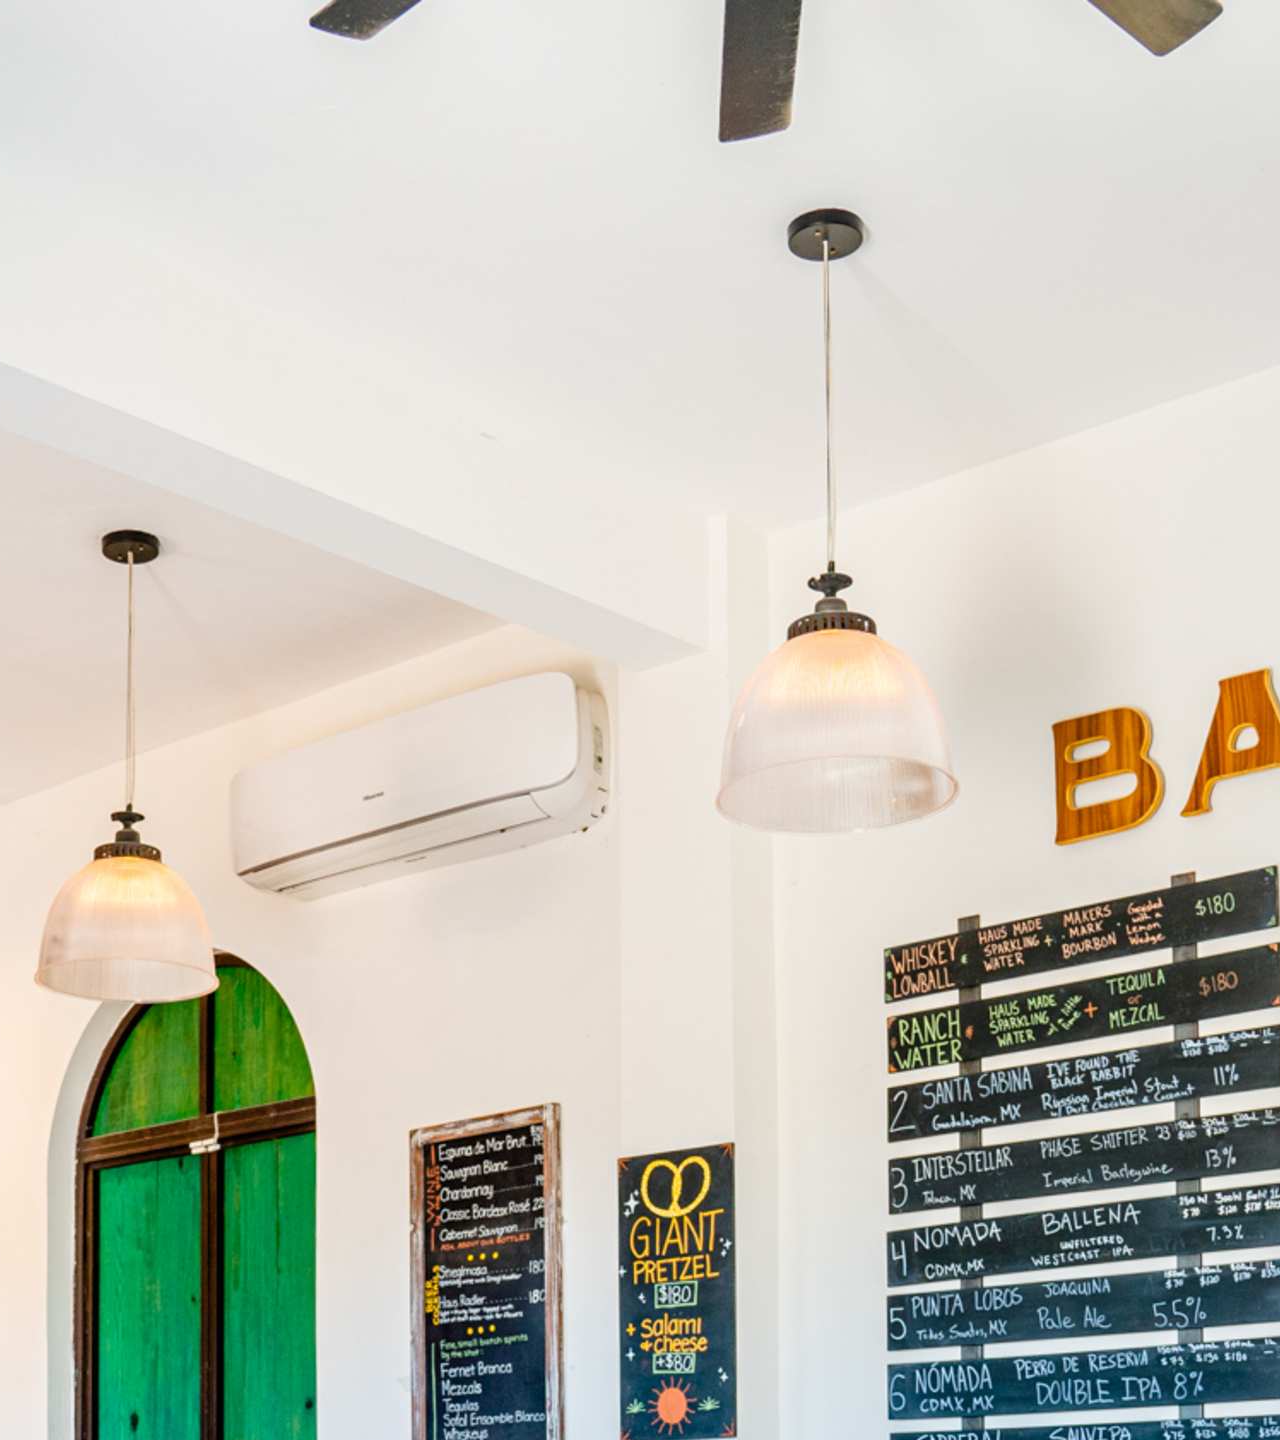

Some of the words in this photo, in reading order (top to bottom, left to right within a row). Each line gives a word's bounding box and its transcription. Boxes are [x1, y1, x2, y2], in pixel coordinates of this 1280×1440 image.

[1063, 904, 1112, 927] MAKERS
[1195, 892, 1236, 916] $180
[978, 926, 1007, 945] HAUS
[1013, 918, 1043, 936] MADE
[1070, 920, 1104, 938] MARK
[1126, 922, 1161, 934] Lemon
[890, 937, 959, 975] WHISKEY
[984, 935, 1040, 957] SPARKLING
[1061, 932, 1117, 959] BOURBON
[984, 953, 1024, 973] WATER
[892, 967, 956, 998] LOWBALL
[1106, 968, 1166, 996] TEQUILA
[1199, 971, 1239, 997] $180
[989, 1001, 1020, 1020] HAUS
[1027, 994, 1057, 1011] MADE
[1109, 1002, 1166, 1029] MEZCAL
[898, 1009, 961, 1047] RANCH
[989, 1011, 1050, 1035] SPARKLING
[997, 1029, 1036, 1048] WATER
[894, 1040, 963, 1070] WATER
[1075, 1055, 1110, 1073] FOUND
[1116, 1050, 1141, 1065] THE
[1051, 1075, 1084, 1089] BLACK
[1091, 1064, 1136, 1082] RABBIT
[1143, 1074, 1180, 1093] Stout
[1213, 1064, 1240, 1086] 11%
[922, 1076, 973, 1110] SANTA
[977, 1067, 1033, 1098] SABINA
[890, 1090, 916, 1133] 2
[1000, 1104, 1022, 1121] MX
[1040, 1137, 1082, 1159] PHASE
[1090, 1128, 1149, 1151] SHIFTER
[1205, 1144, 1237, 1168] 13%
[483, 1159, 508, 1174] Blanc
[912, 1147, 1013, 1183] INTERSTELLAR
[1042, 1168, 1093, 1189] Imperial
[1100, 1163, 1174, 1186] Barleywine
[440, 1185, 494, 1202] Chardonnay
[891, 1167, 908, 1208] 3
[959, 1184, 977, 1201] MX
[1041, 1203, 1141, 1236] BALLENA
[629, 1208, 724, 1258] GIANT
[913, 1221, 1002, 1252] NOMADA
[1060, 1235, 1124, 1250] UNFILTERED
[1206, 1224, 1244, 1242] 7.3%
[891, 1240, 908, 1277] 4
[1112, 1246, 1134, 1258] IPA
[633, 1254, 720, 1284] PRETZEL
[658, 1285, 691, 1304] $180
[1042, 1278, 1111, 1298] JOAQUINA
[911, 1293, 964, 1319] PUNTA
[974, 1287, 1023, 1311] LOBOS
[1152, 1297, 1207, 1329] 5.5%
[640, 1312, 702, 1338] salami
[889, 1307, 907, 1340] 5
[989, 1319, 1008, 1336] MX
[1037, 1306, 1076, 1330] Pale
[1083, 1305, 1112, 1329] Ale
[654, 1335, 708, 1353] cheese
[440, 1363, 475, 1378] Fernet
[478, 1361, 513, 1375] Branca
[1014, 1358, 1055, 1381] PERRO
[1062, 1356, 1079, 1373] DE
[1088, 1350, 1148, 1373] RESERVA
[442, 1380, 482, 1395] Mezcals
[890, 1373, 906, 1412] 6
[1036, 1378, 1114, 1405] DOUBLE
[1121, 1375, 1162, 1400] IPA
[1173, 1371, 1204, 1400] 8%
[443, 1398, 479, 1412] Tequilas
[515, 1410, 545, 1422] Blanco
